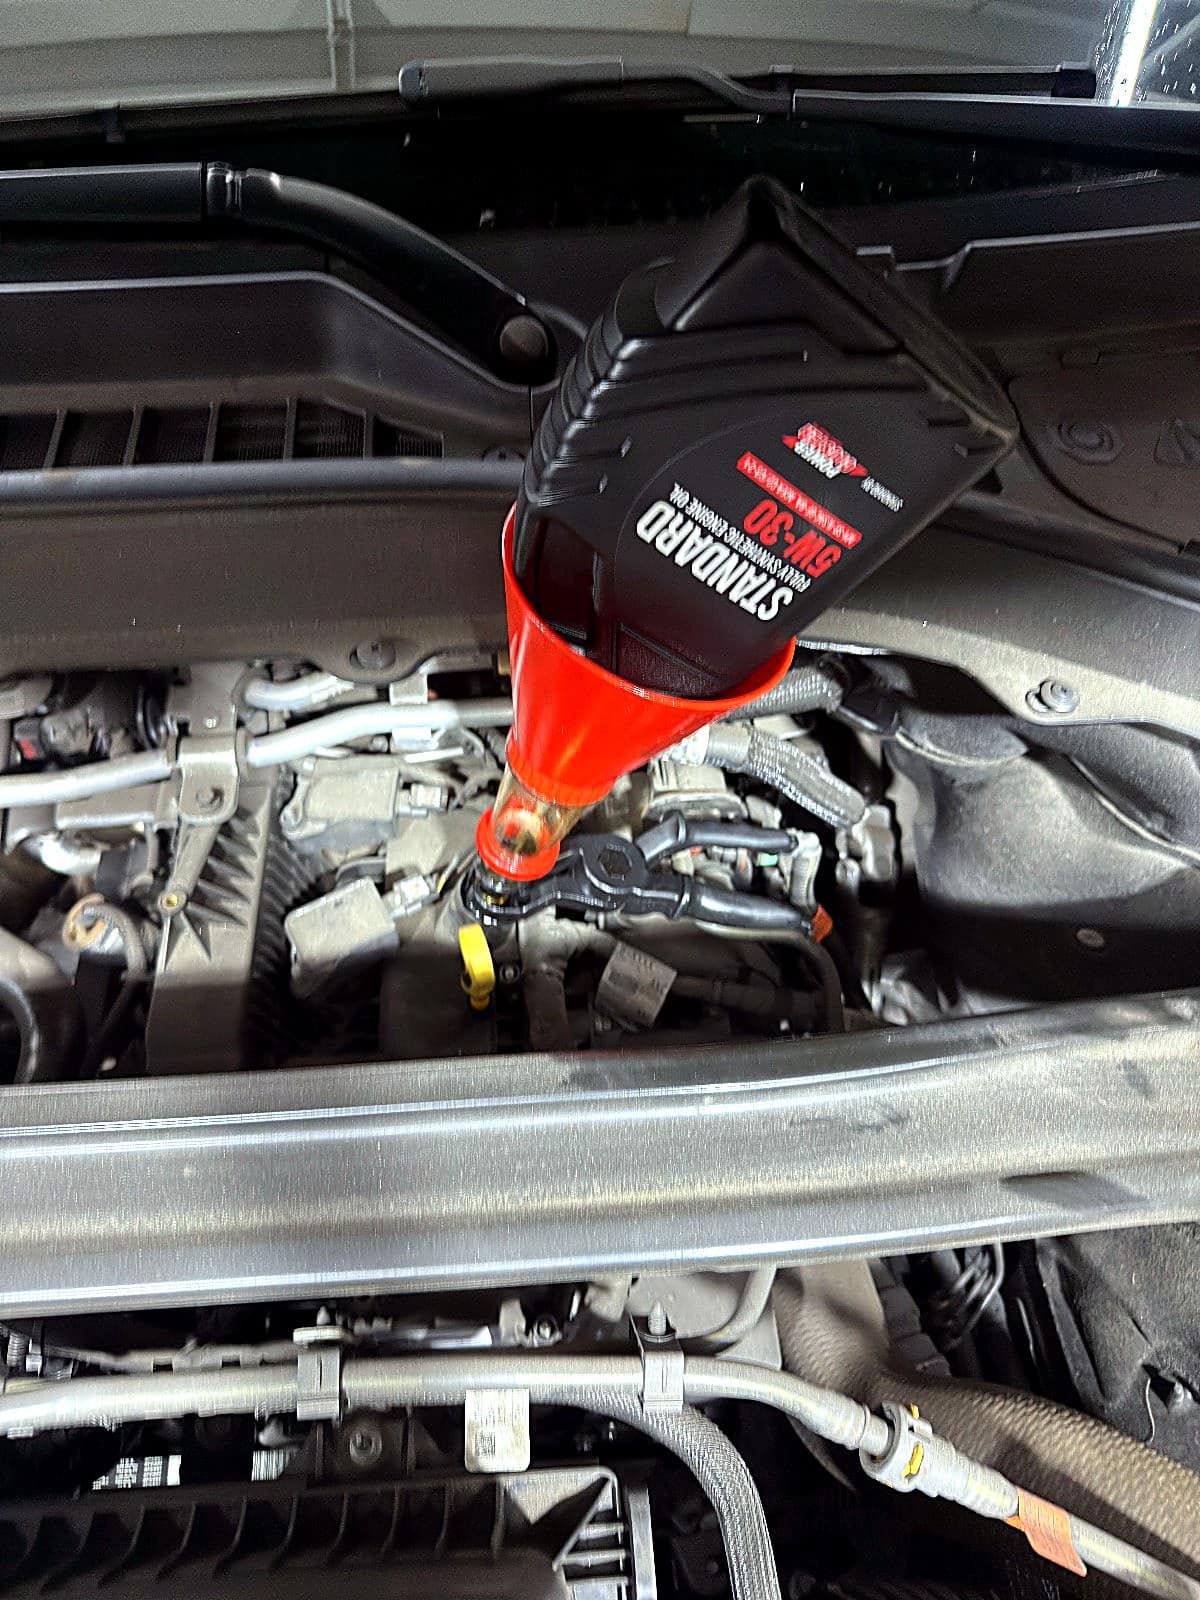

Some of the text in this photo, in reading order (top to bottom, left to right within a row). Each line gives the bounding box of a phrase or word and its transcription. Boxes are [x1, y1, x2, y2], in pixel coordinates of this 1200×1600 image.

[794, 439, 841, 479] POWER
[636, 500, 794, 621] STANDARD
[669, 482, 811, 592] FULLY SYNTHETIC ENGINE OIL
[744, 500, 841, 578] 5W-30
